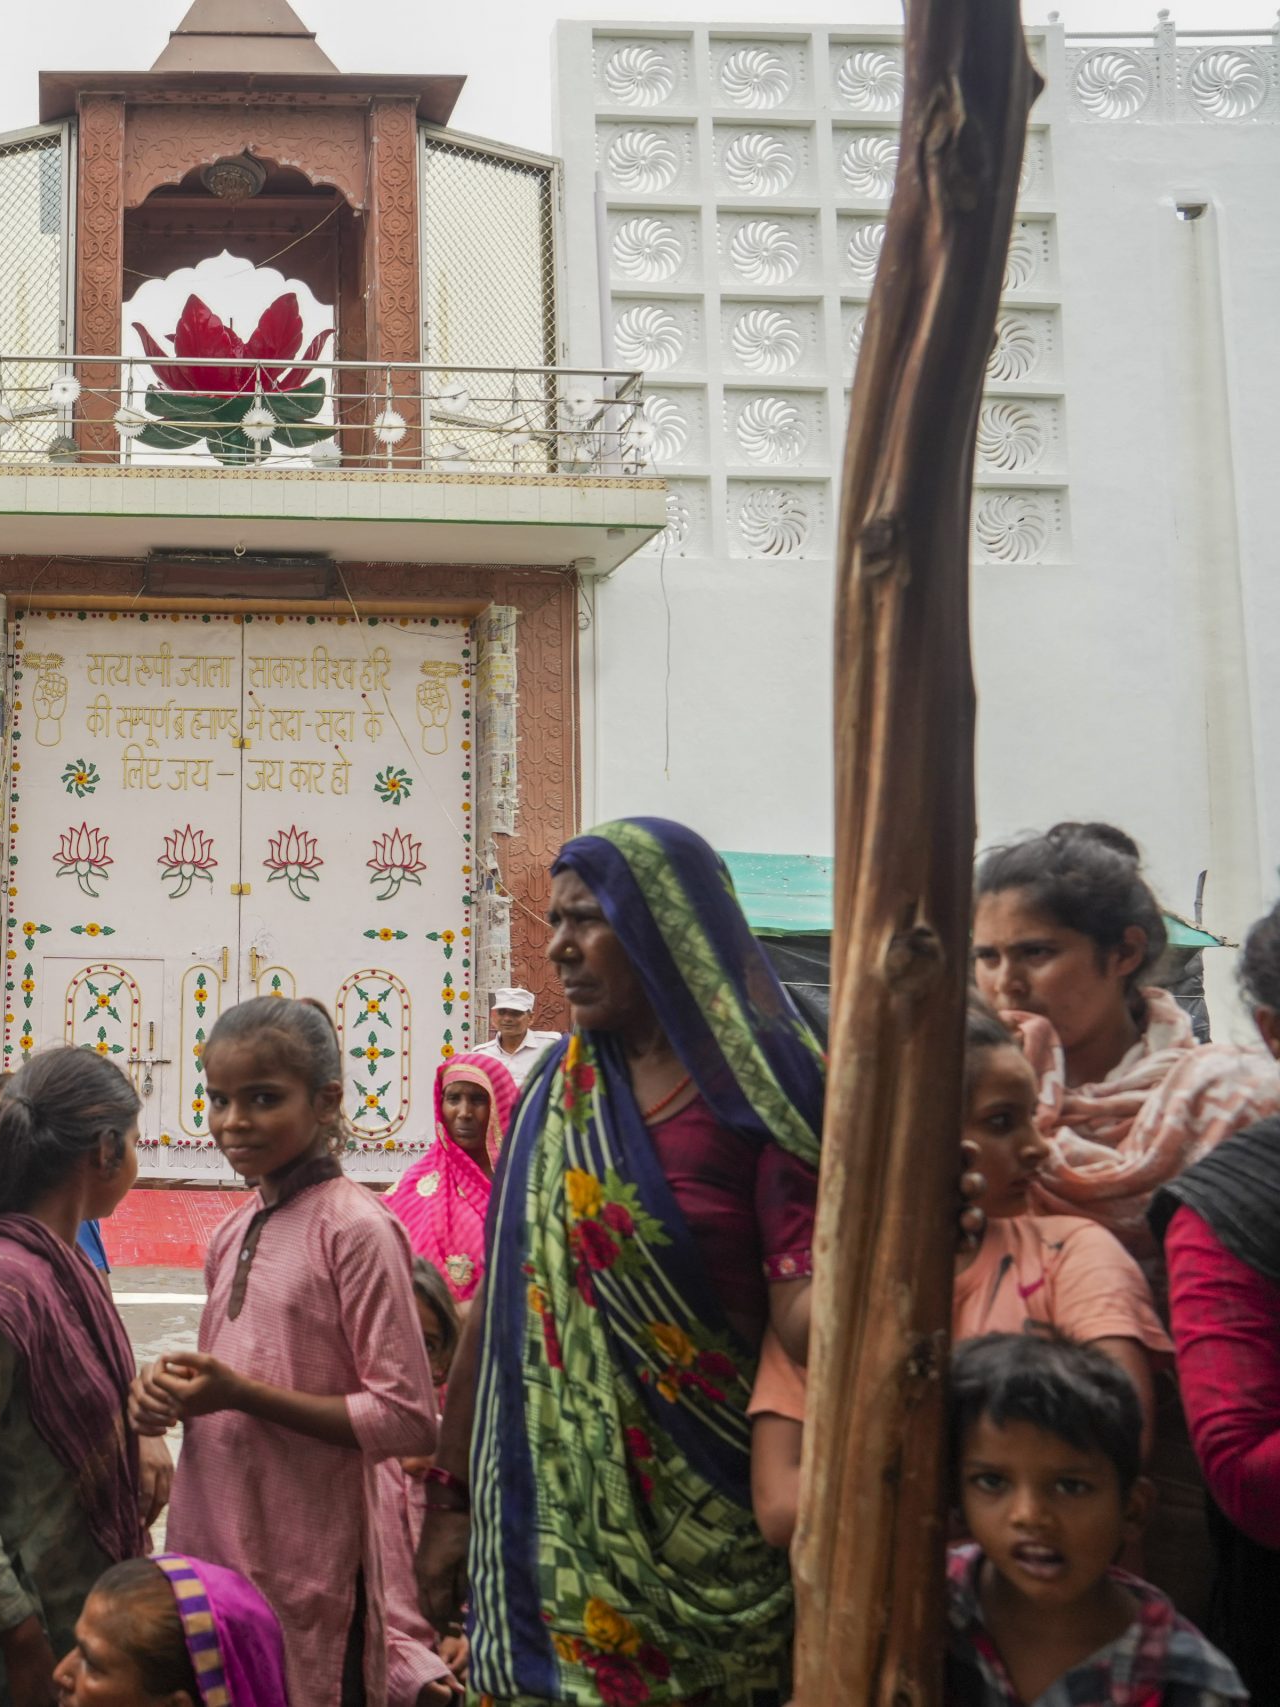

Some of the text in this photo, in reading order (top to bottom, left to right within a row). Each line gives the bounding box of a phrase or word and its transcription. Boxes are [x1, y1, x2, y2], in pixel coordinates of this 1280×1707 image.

[86, 654, 132, 686] सत्य
[176, 655, 236, 688] ज्वाला
[248, 656, 308, 689] साकार
[359, 646, 392, 692] हरि
[86, 694, 113, 738] की
[116, 699, 176, 748] सम्पूर्ण
[361, 693, 385, 743] के
[121, 743, 164, 790] लिए
[167, 759, 213, 791] जय
[246, 759, 284, 792] जय
[289, 760, 326, 794] कार
[331, 744, 353, 795] हो
